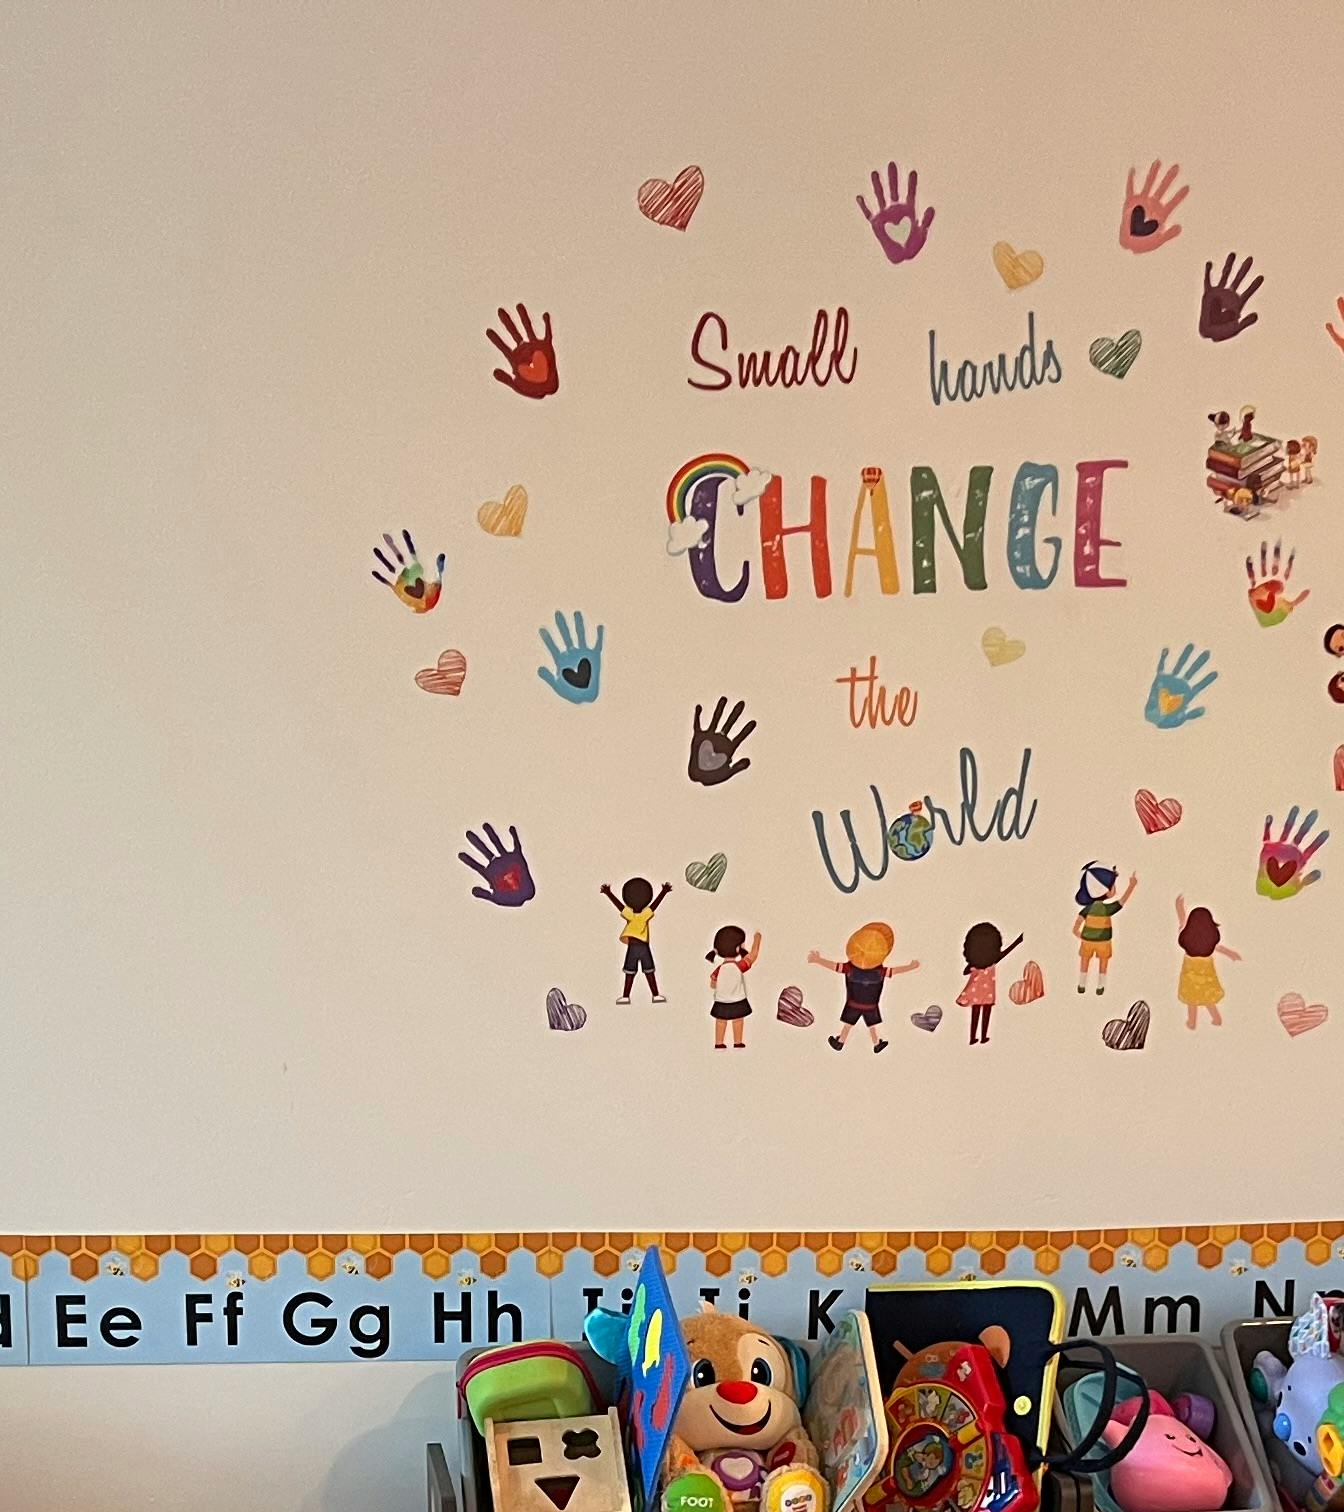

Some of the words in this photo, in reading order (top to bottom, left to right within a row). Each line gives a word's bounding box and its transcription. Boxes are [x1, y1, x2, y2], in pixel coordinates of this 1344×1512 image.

[687, 306, 858, 392] Small
[928, 310, 1063, 407] hands
[688, 459, 1129, 604] CHANGE
[834, 655, 918, 730] the
[811, 746, 1039, 895] World
[55, 1294, 142, 1348] Ee
[185, 1291, 244, 1346] Ff
[282, 1291, 390, 1359] Gg
[433, 1290, 523, 1344] Hh
[1067, 1285, 1201, 1338] Mm
[680, 1495, 714, 1508] FOOT
